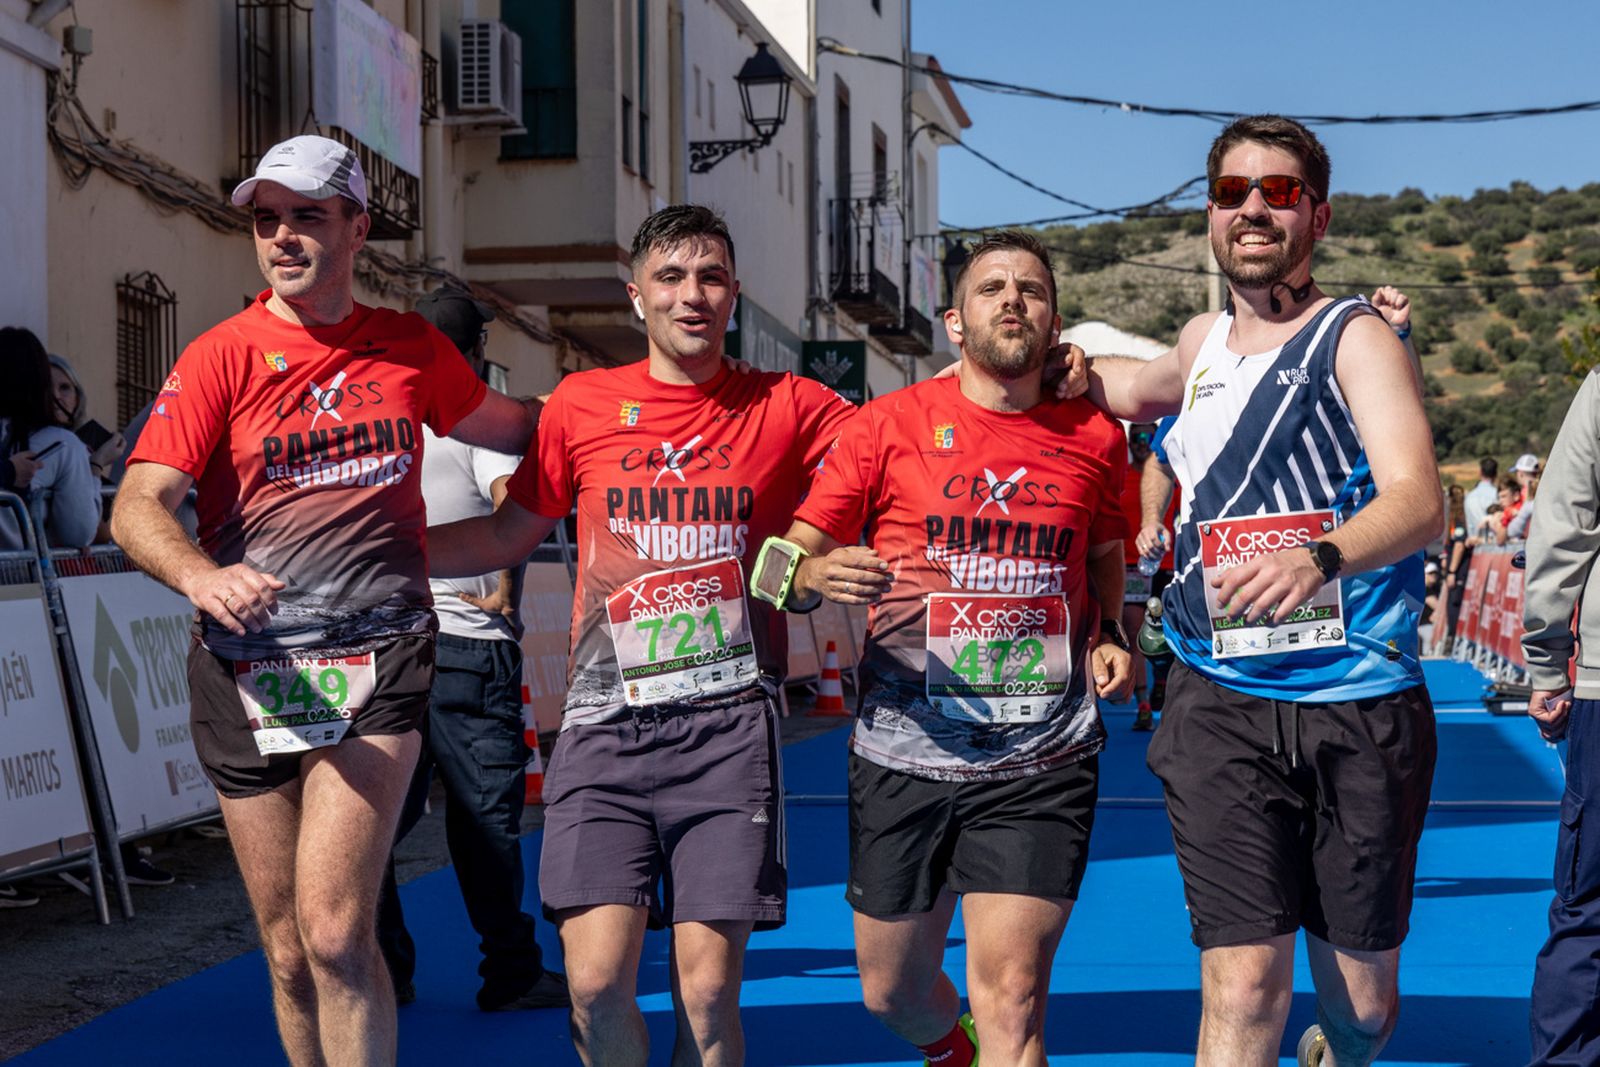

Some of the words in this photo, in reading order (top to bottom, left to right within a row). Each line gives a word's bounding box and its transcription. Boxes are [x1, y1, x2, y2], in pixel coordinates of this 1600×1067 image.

[1291, 368, 1308, 376] RUN
[1291, 376, 1309, 385] PRO
[276, 380, 384, 420] CROSS
[262, 417, 416, 469] PANTANO
[620, 443, 734, 472] CROSS
[265, 465, 293, 482] DEL
[291, 454, 413, 490] VÍBORAS
[606, 485, 755, 523] PANTANO
[942, 474, 1061, 509] CROSS
[608, 517, 634, 534] DEL
[632, 516, 750, 563] VÍBORAS
[925, 515, 1075, 562] PANTANO
[1214, 526, 1233, 553] X
[1235, 528, 1311, 551] CROSS
[926, 545, 951, 562] DEL
[949, 547, 1064, 595] VÍBORAS
[627, 582, 651, 609] X
[652, 576, 723, 603] CROSS
[629, 596, 709, 623] PANTANO
[950, 601, 973, 626] X
[976, 608, 1047, 627] CROSS
[635, 604, 726, 663] 721
[949, 626, 1030, 642] PANTANO
[250, 658, 332, 677] PANTANO
[623, 664, 661, 679] ANTONIO
[662, 659, 685, 672] JOSE
[951, 637, 1046, 685] 472
[255, 667, 348, 715] 349
[263, 715, 288, 728] LUIS
[0, 748, 62, 801] MARTOS
